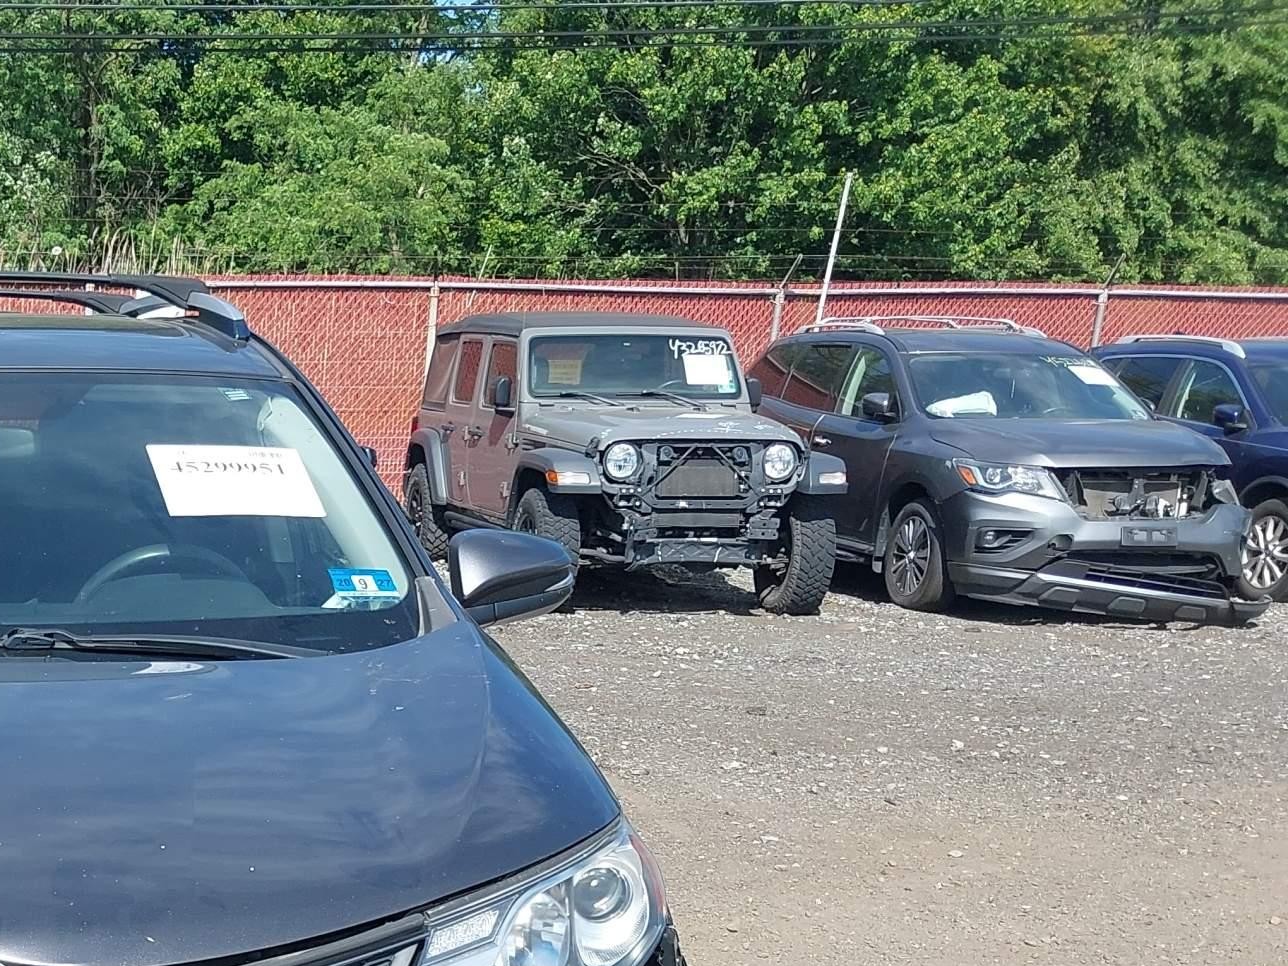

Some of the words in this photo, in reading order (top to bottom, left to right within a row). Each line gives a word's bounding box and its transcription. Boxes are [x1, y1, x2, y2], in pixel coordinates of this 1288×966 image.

[171, 461, 285, 475] 45299951
[358, 578, 368, 590] 9
[377, 579, 391, 587] 27
